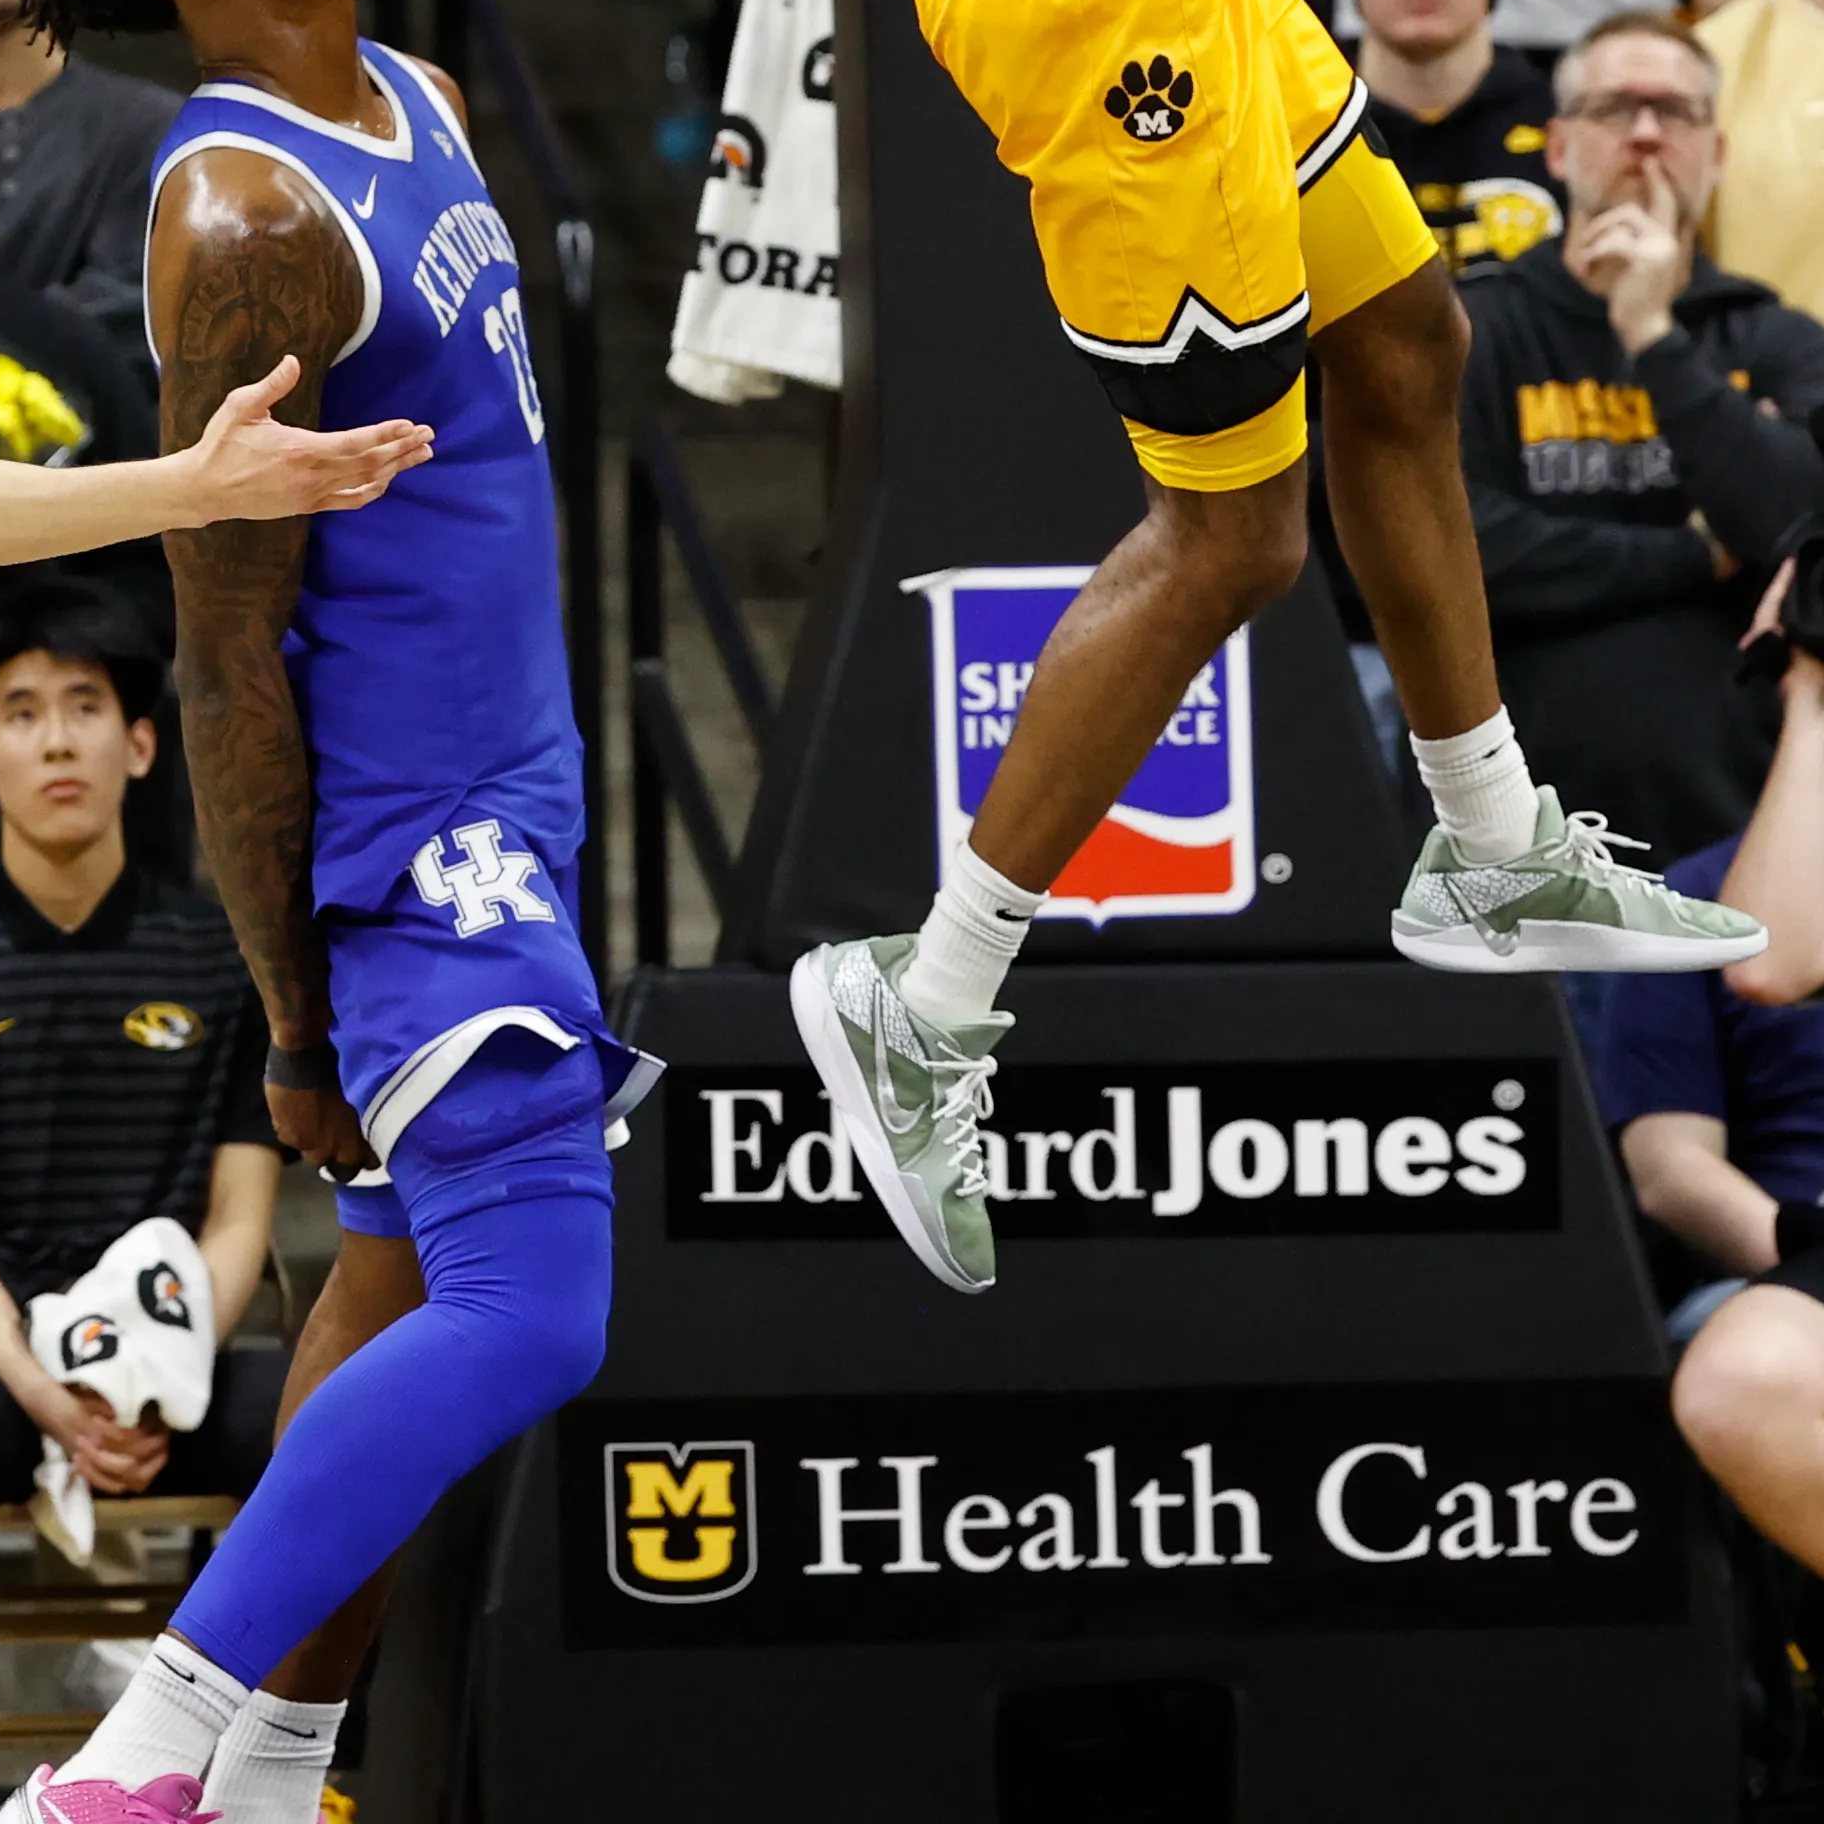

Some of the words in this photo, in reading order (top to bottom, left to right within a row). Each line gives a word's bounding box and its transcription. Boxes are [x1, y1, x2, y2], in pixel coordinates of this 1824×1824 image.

[1133, 109, 1173, 138] M
[412, 200, 520, 340] KENTUCK
[699, 1087, 1146, 1204] Edard
[798, 1443, 1273, 1576] Health
[1315, 1442, 1640, 1563] Care
